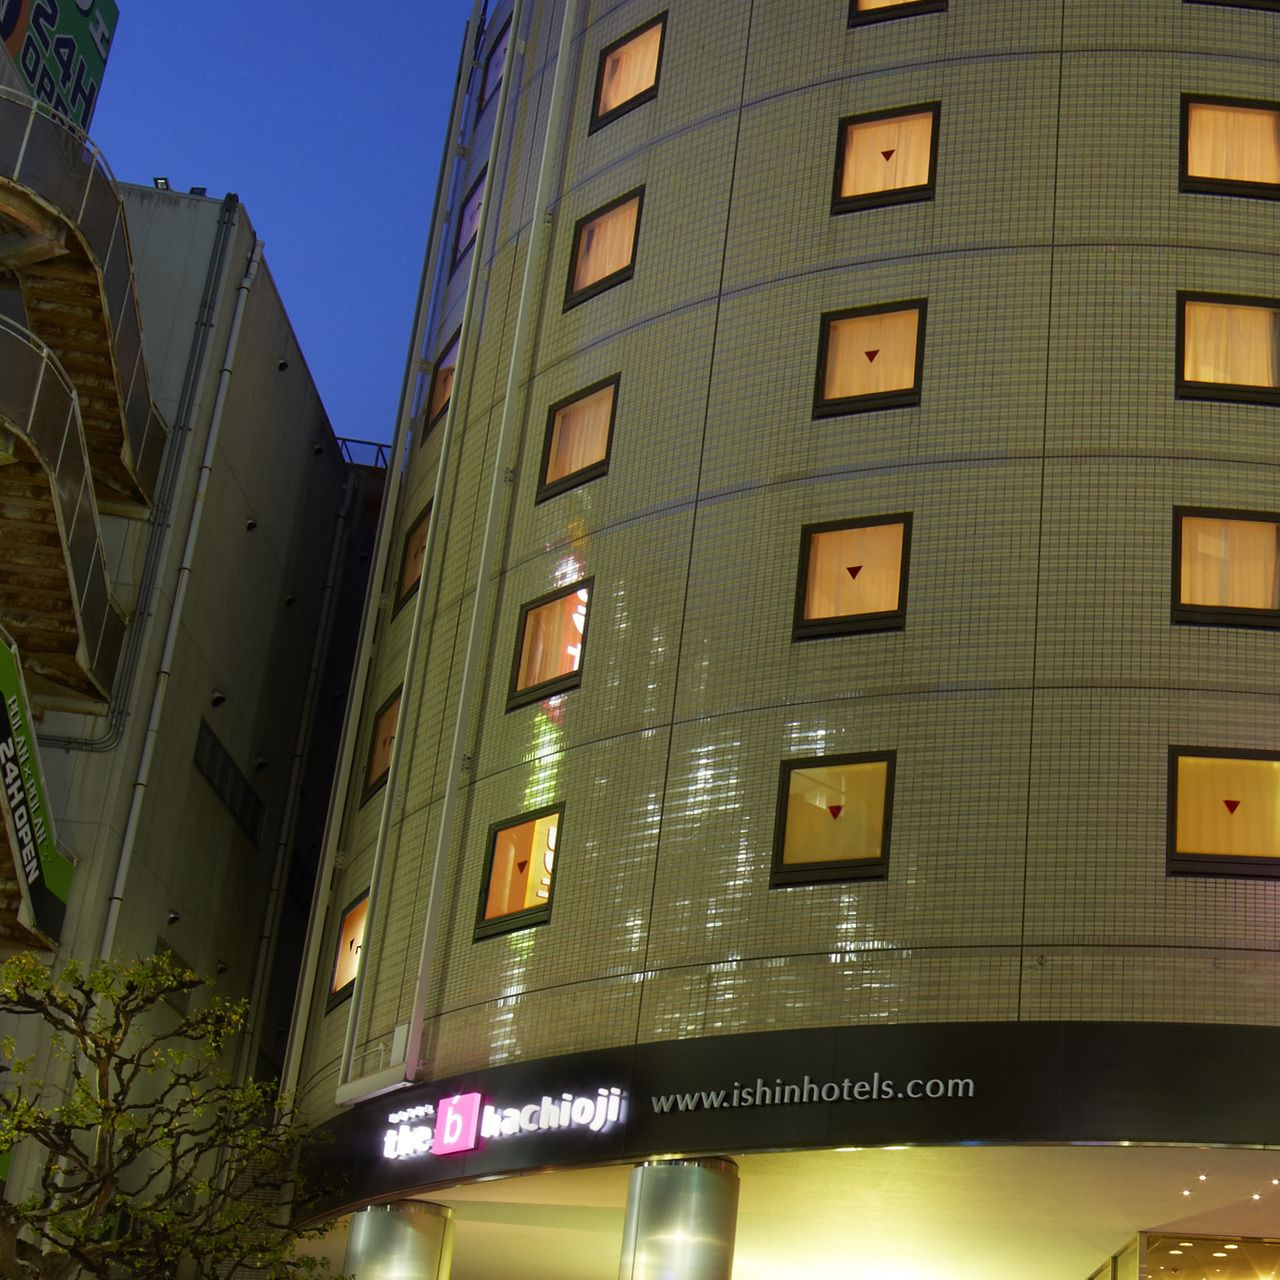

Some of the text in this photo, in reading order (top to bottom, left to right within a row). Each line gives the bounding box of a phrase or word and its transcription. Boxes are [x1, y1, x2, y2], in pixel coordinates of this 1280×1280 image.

[14, 802, 41, 885] OPEN
[384, 1087, 622, 1159] the b hachioji
[651, 1071, 975, 1114] www.ishinhotels.com
